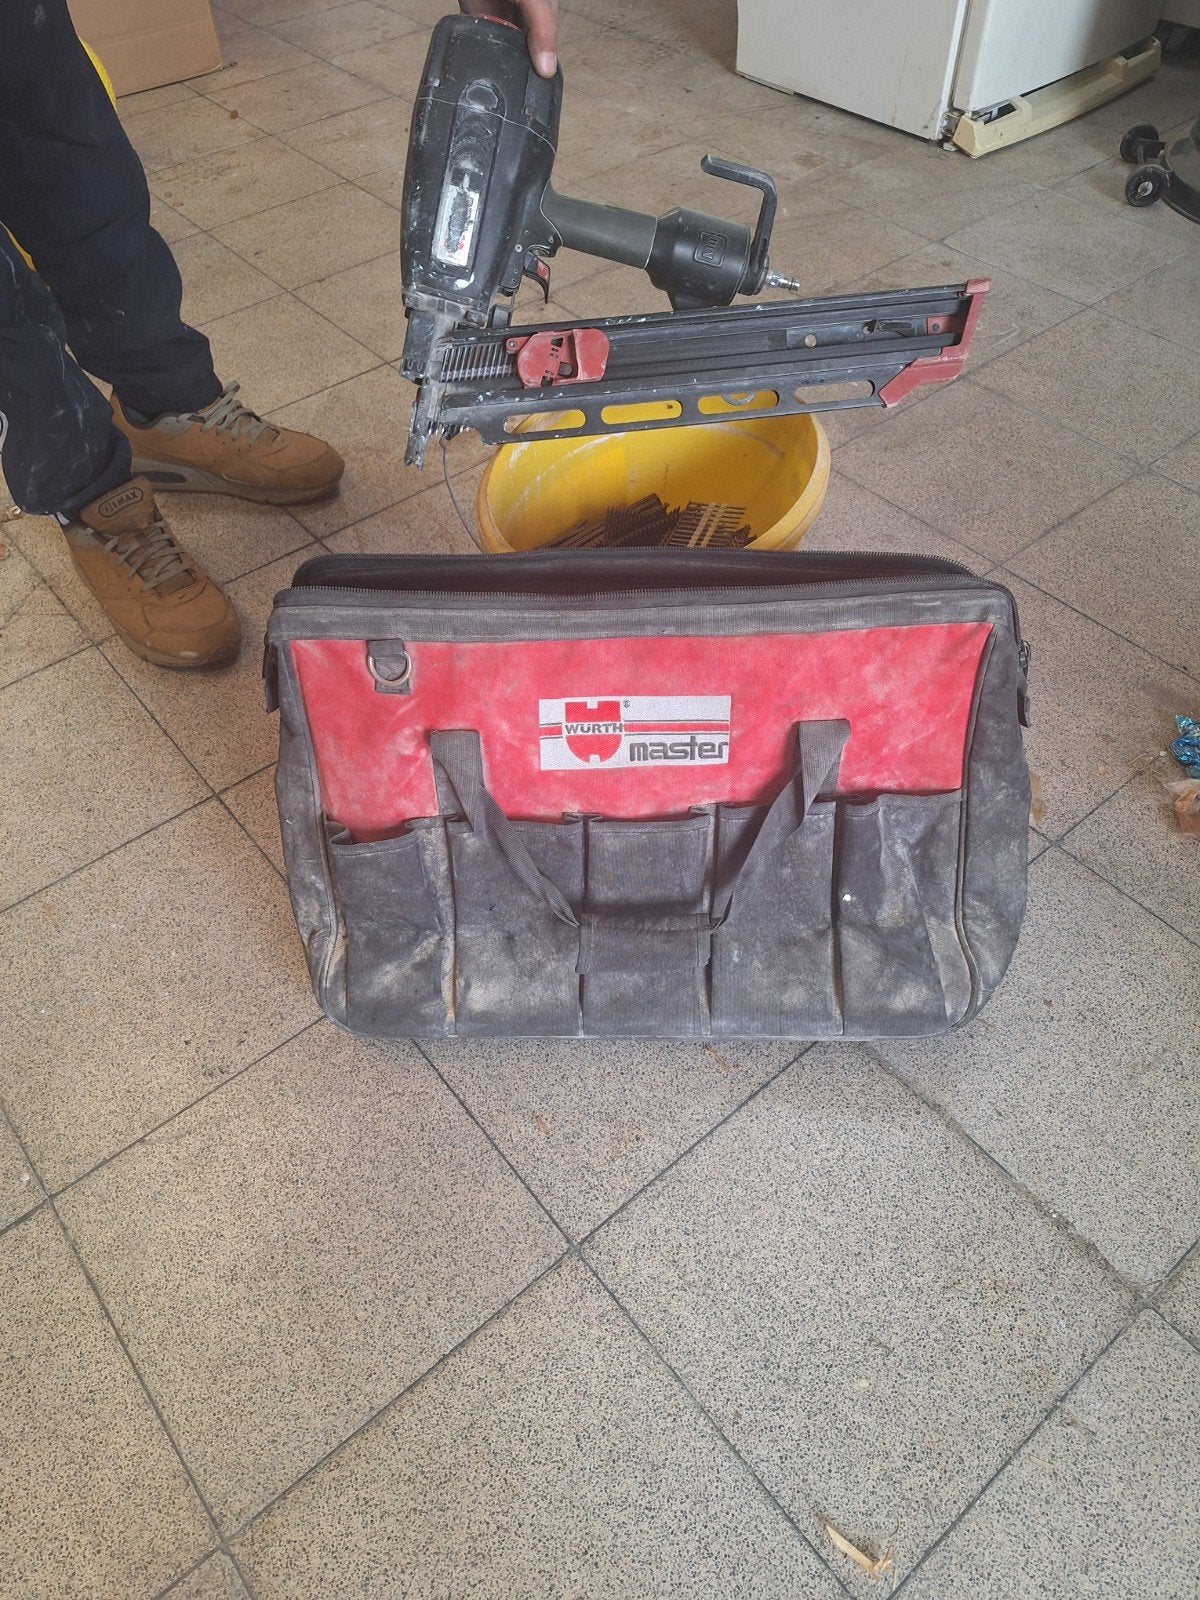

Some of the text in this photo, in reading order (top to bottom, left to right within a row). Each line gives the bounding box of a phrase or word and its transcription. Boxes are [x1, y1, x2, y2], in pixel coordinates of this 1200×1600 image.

[104, 490, 138, 512] AIRMAX
[564, 722, 623, 735] WÜRTH
[629, 735, 729, 762] master
